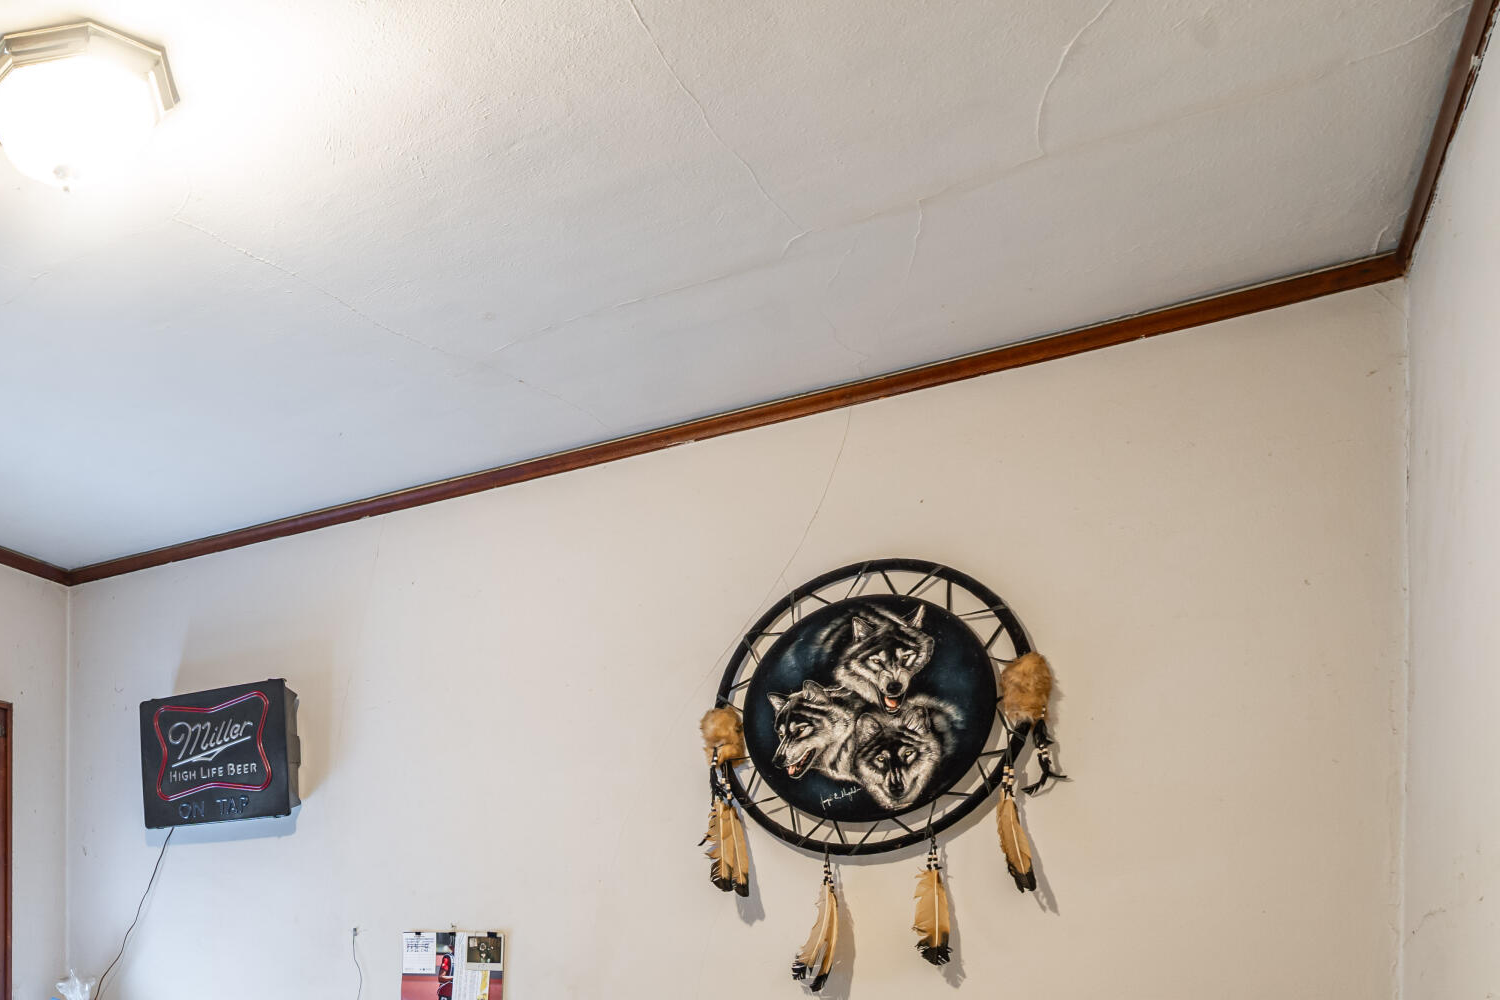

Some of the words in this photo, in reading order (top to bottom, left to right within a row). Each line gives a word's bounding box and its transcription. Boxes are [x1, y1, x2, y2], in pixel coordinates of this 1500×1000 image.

[168, 719, 253, 760] Miller
[169, 770, 197, 783] HIGH
[200, 766, 224, 779] LIFE
[227, 762, 257, 776] BEER
[179, 800, 205, 819] ON
[216, 795, 249, 815] TAP
